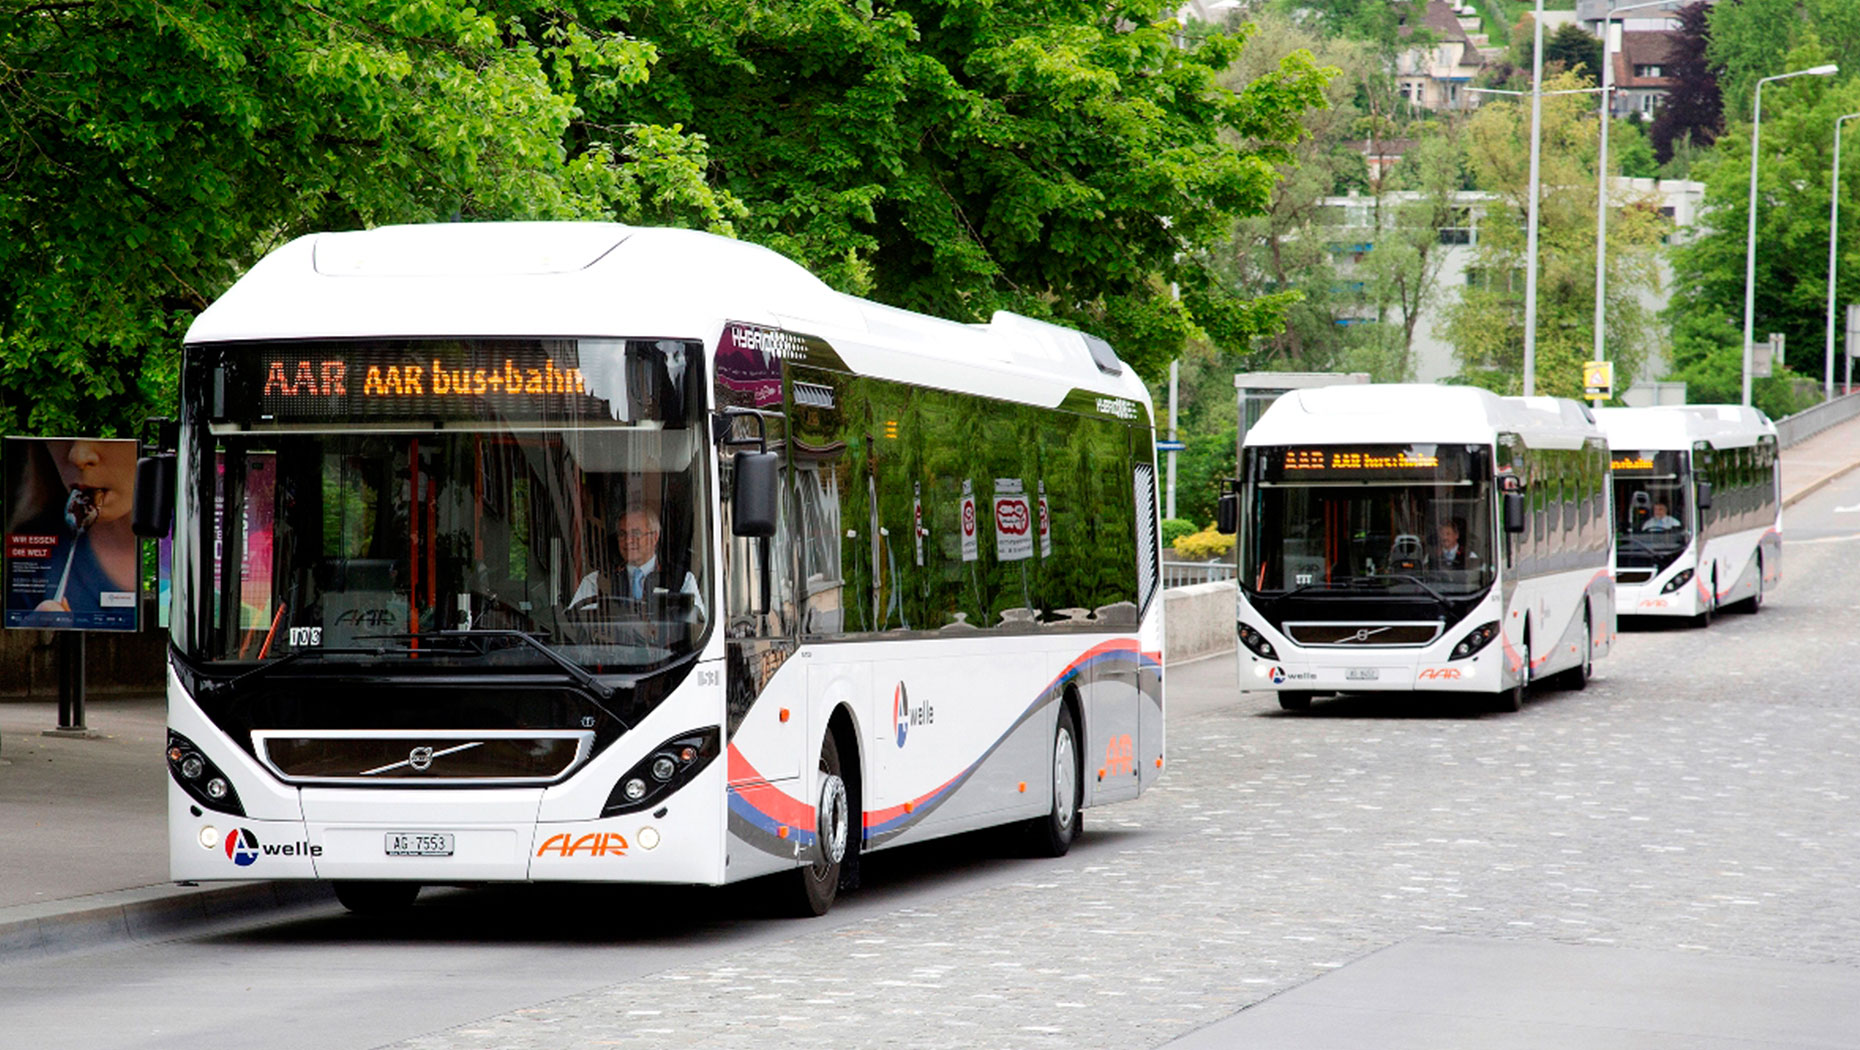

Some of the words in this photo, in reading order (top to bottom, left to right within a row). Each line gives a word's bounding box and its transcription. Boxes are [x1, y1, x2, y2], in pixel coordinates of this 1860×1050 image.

[263, 361, 347, 396] AAR
[363, 365, 424, 396] AAR
[432, 358, 586, 396] bus+bahn
[11, 535, 28, 544] WIR
[28, 535, 56, 545] ESSEN
[11, 548, 27, 557] DIE
[27, 548, 48, 557] WELT
[1418, 667, 1462, 681] AAR
[909, 699, 934, 726] welle
[262, 841, 323, 857] welle
[393, 836, 408, 850] AG
[416, 836, 446, 851] 7553
[536, 832, 629, 857] AAR
